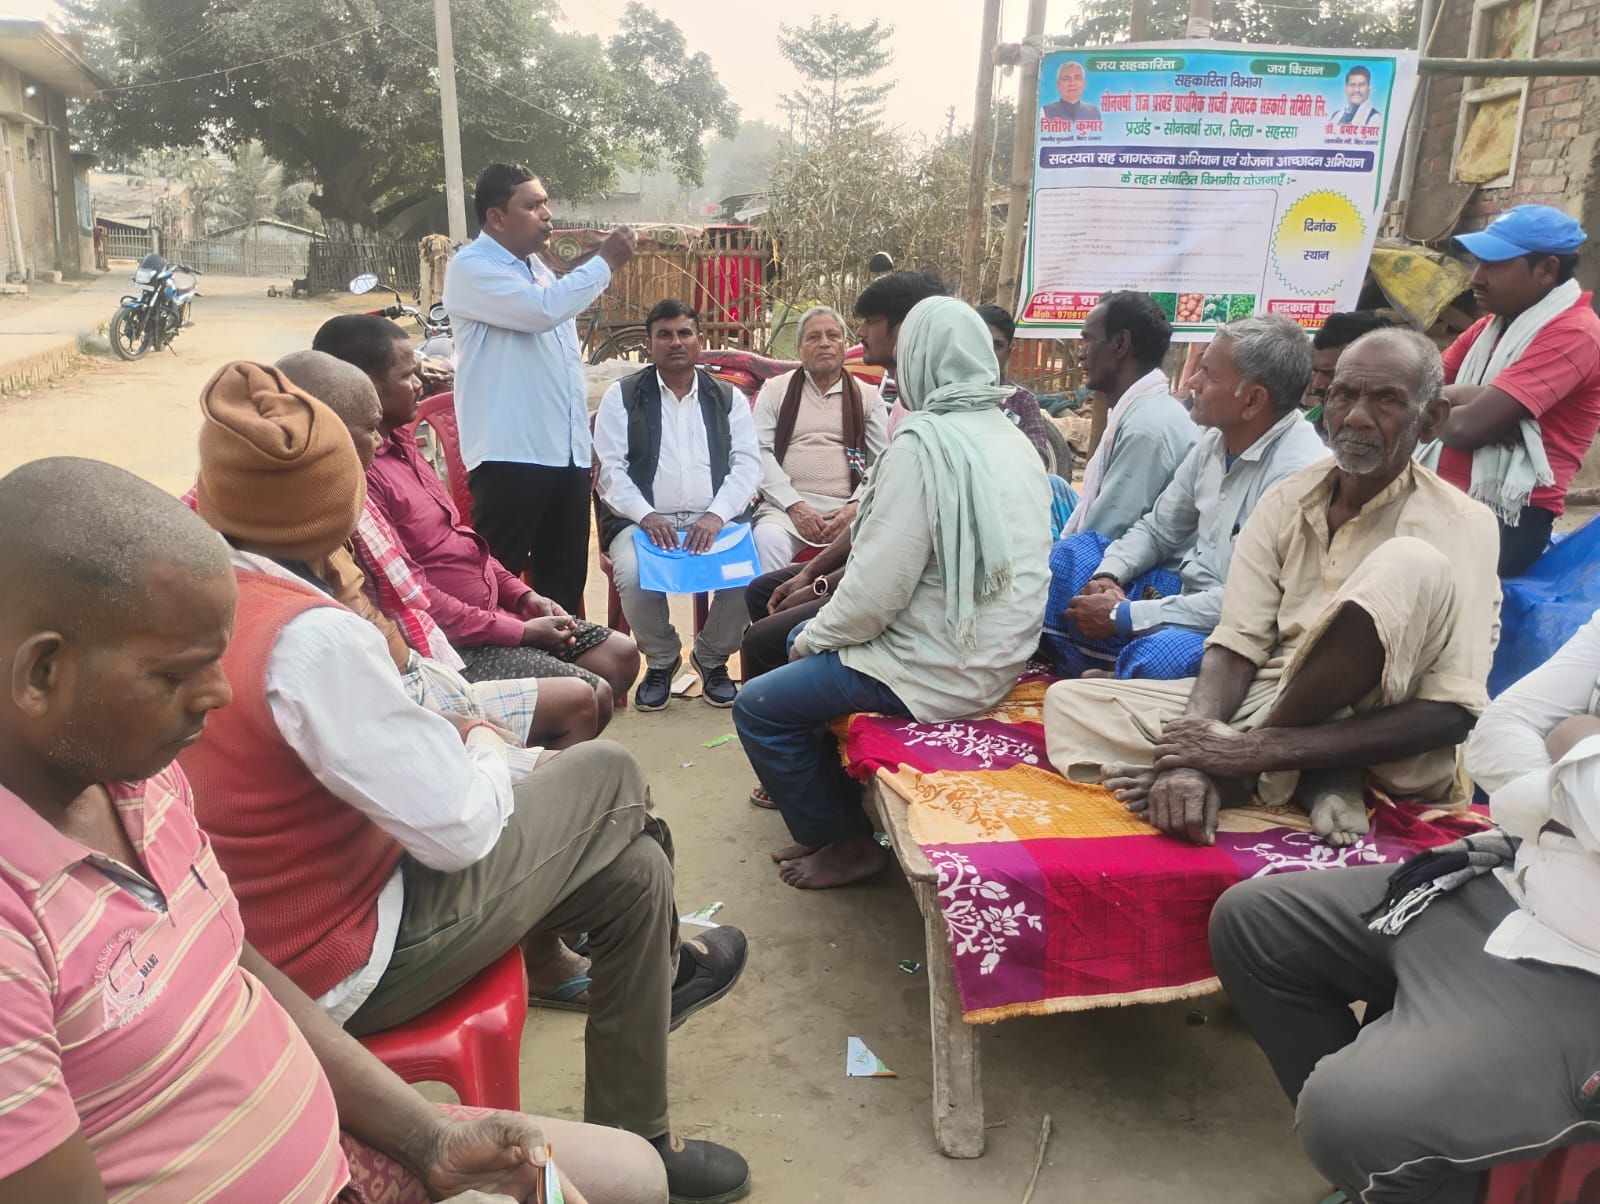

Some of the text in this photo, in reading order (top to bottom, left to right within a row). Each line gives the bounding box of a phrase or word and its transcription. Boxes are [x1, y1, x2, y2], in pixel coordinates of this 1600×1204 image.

[1096, 57, 1176, 71] जय सहकारिता
[1267, 62, 1324, 75] जय किसान
[1175, 71, 1262, 88] सहकारिता विभाग
[1101, 89, 1132, 112] सोनवर्षा
[1135, 94, 1149, 112] राज
[1152, 90, 1173, 112] प्रखंड
[1174, 90, 1205, 113] प्राथमिक
[1260, 93, 1287, 115] सहकारी
[1290, 94, 1312, 116] समिति
[1040, 117, 1103, 135] नितीश कुमार
[1126, 118, 1151, 136] प्रखंड
[1164, 118, 1202, 135] सोनवर्षा
[1229, 119, 1253, 137] जिला
[1049, 151, 1365, 168] सदस्यता सह जागरूकता अभियान एवं योजना आच्छादन अभियान
[1120, 171, 1131, 184] के
[1134, 174, 1157, 185] तहत
[1201, 171, 1240, 186] विभागीय
[1304, 218, 1337, 232] दिनांक
[1304, 251, 1330, 260] स्थान
[139, 954, 159, 977] BRAND
